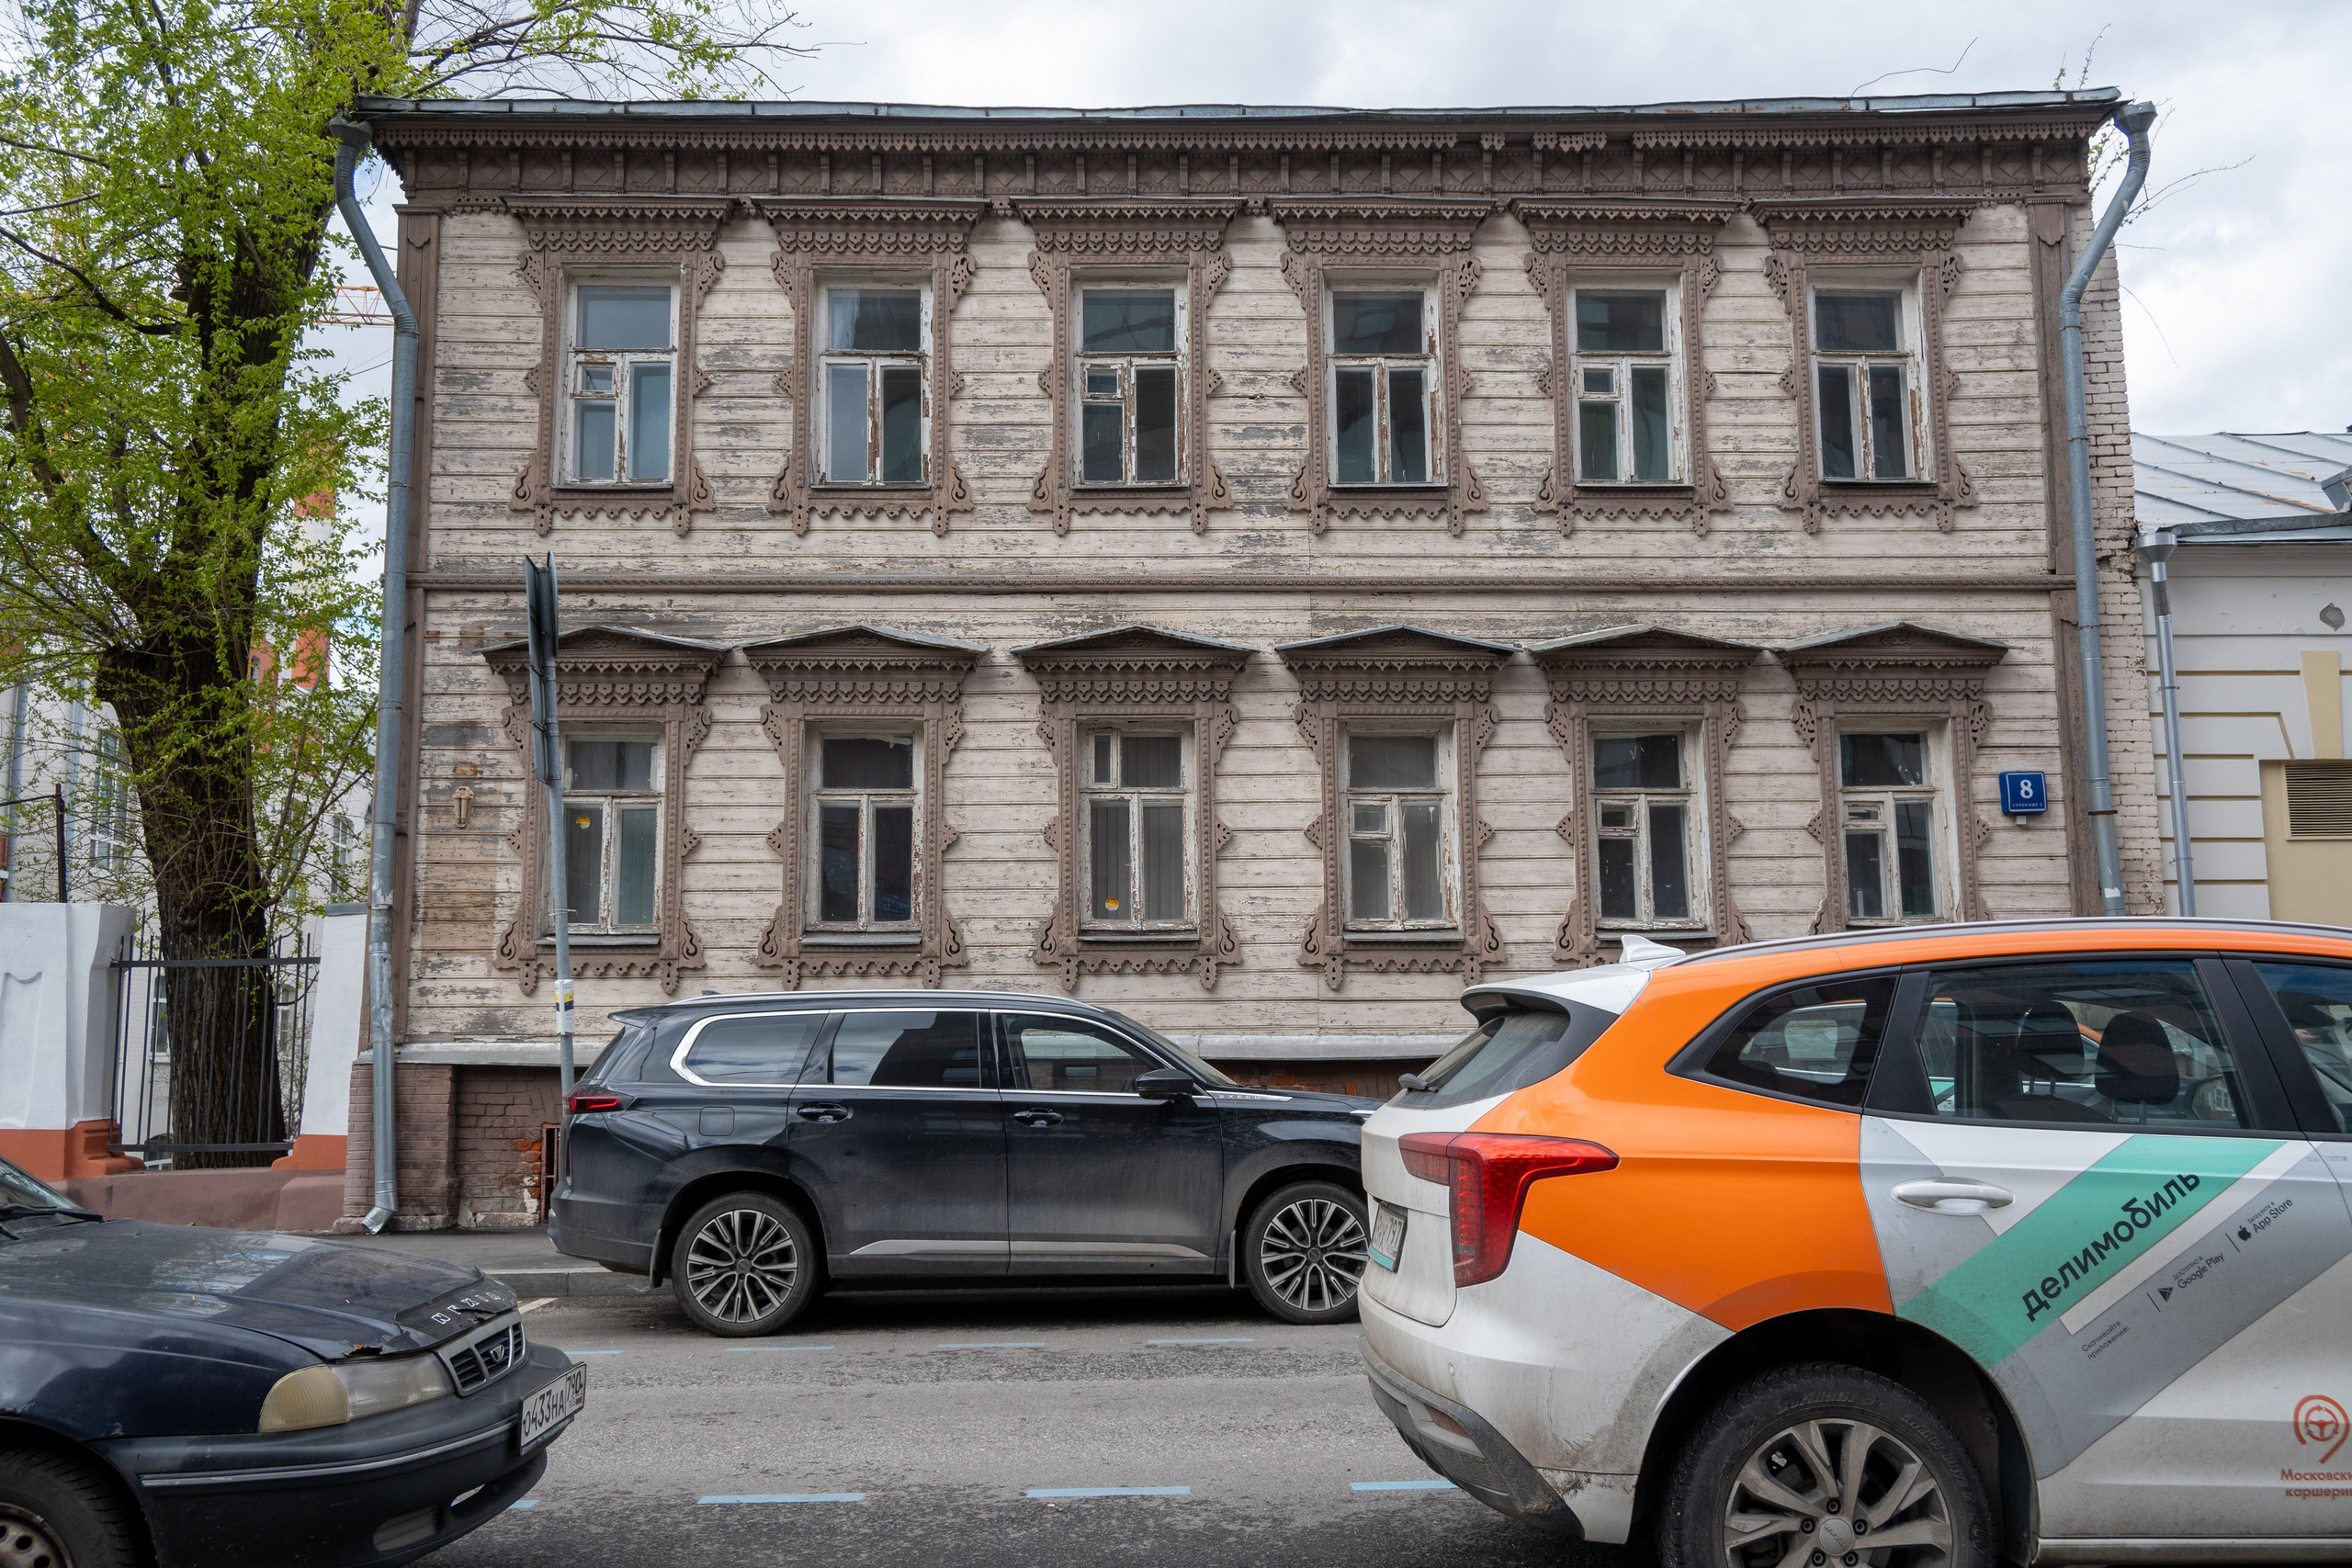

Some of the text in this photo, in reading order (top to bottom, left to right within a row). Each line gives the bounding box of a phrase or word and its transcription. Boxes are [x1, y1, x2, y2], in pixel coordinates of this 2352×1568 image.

[2019, 779, 2033, 799] 8
[2253, 1199, 2293, 1233] App Store
[2022, 1174, 2200, 1323] делимобиль
[2177, 1253, 2225, 1289] Google Play
[2081, 1321, 2121, 1352] Скачивайте
[2087, 1325, 2130, 1359] приложение:
[2285, 1488, 2352, 1500] каршери
